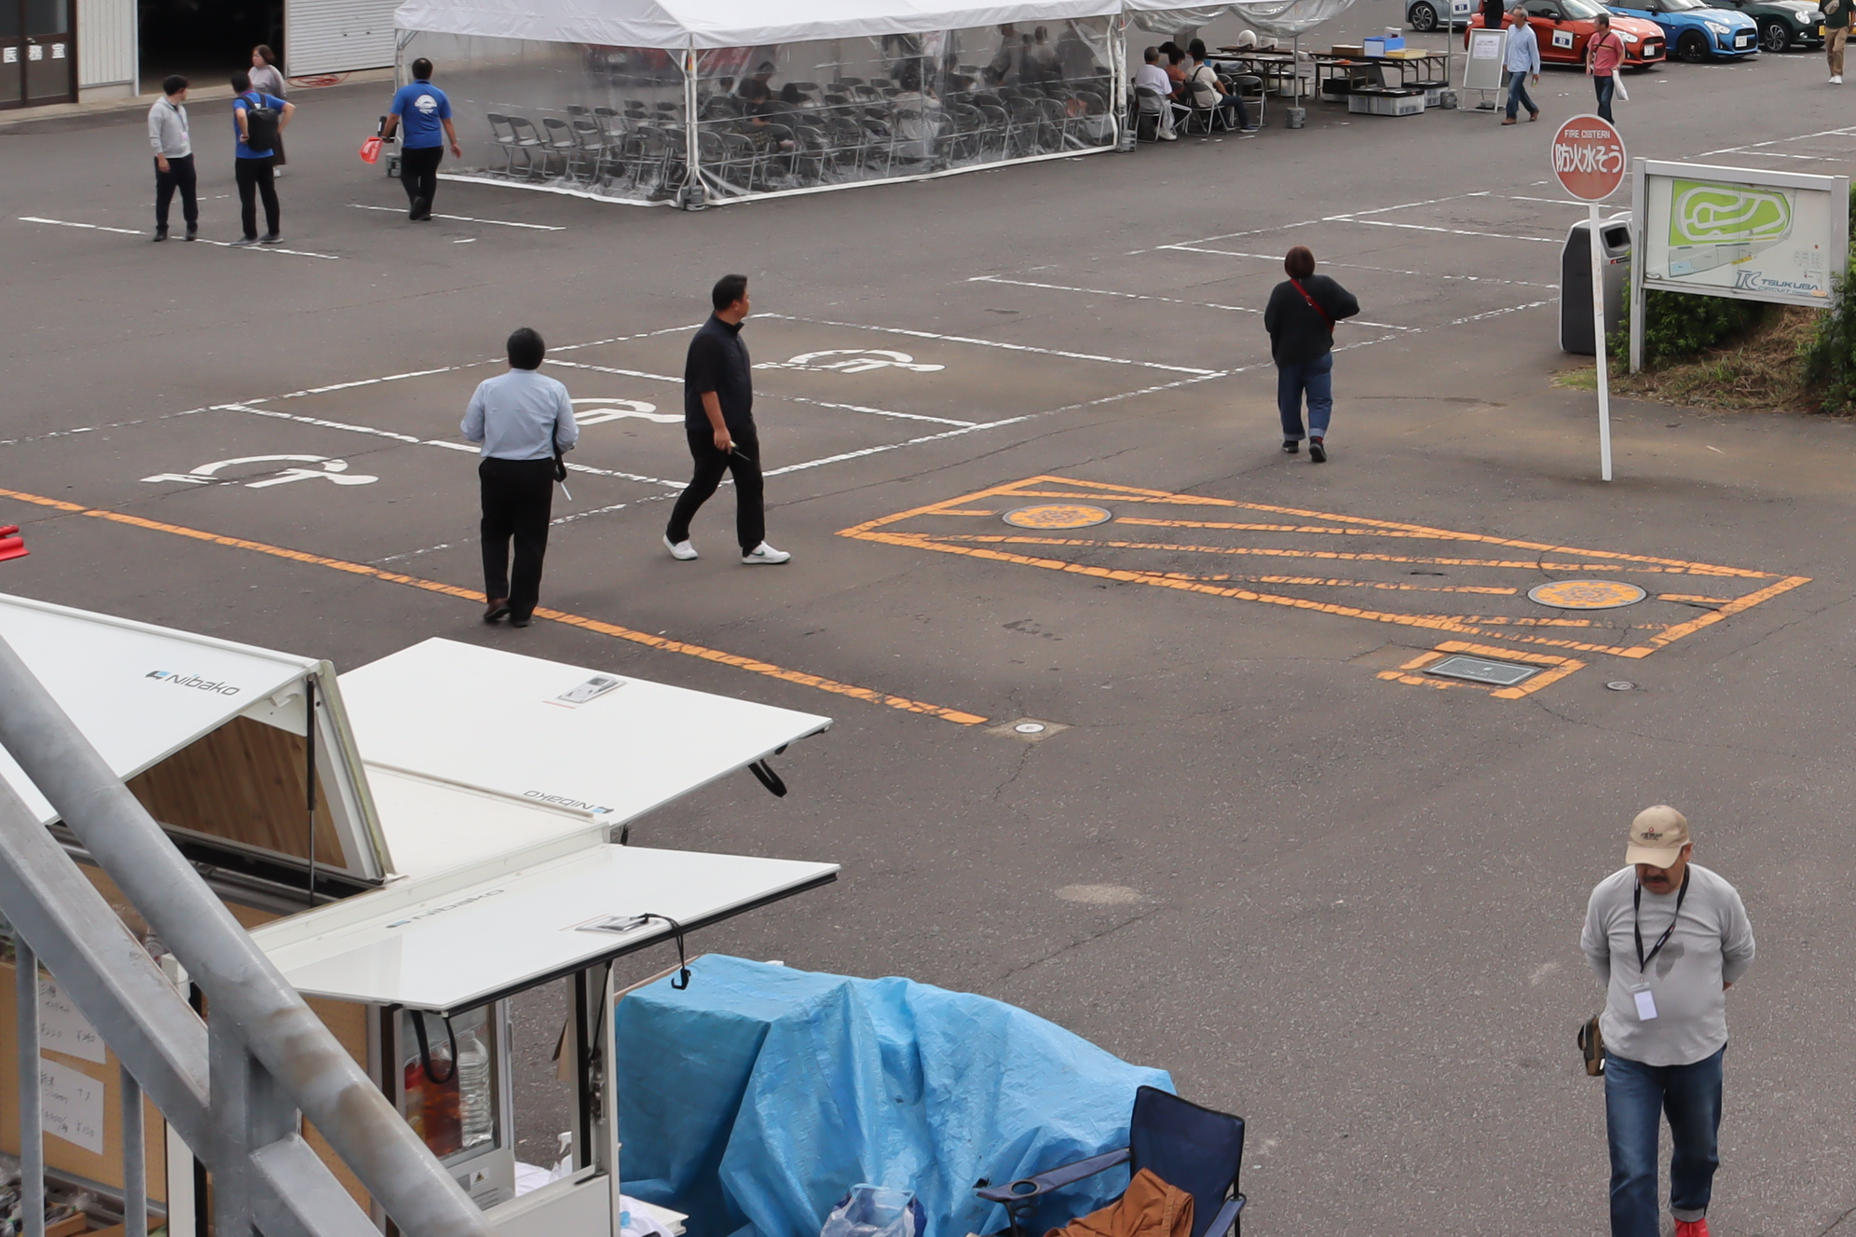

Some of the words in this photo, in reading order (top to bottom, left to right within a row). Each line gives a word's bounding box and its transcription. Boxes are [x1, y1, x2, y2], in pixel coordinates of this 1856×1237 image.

[1564, 129, 1580, 139] FIRE
[1581, 129, 1611, 139] CISTERN
[1554, 142, 1623, 174] 防火水そう
[1761, 278, 1819, 290] TSUKUBA
